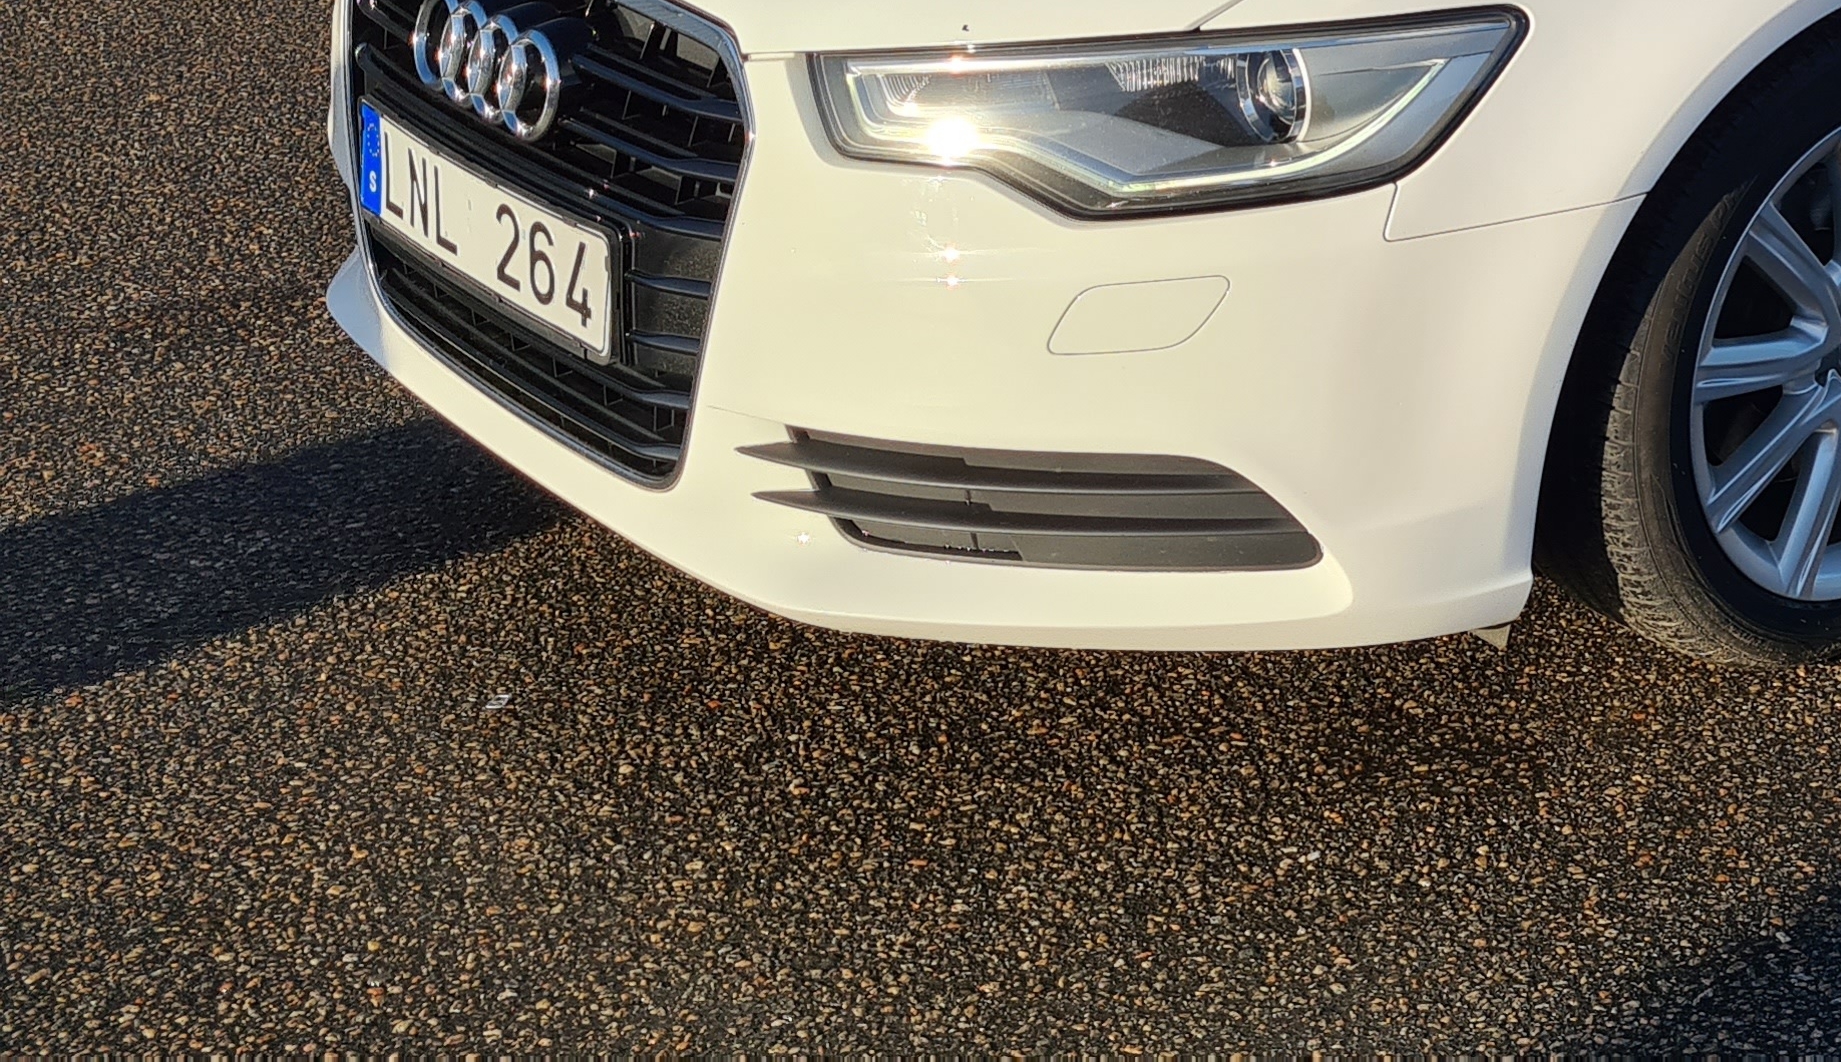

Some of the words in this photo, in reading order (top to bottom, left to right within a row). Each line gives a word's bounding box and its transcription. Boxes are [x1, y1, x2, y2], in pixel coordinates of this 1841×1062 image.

[369, 170, 377, 193] S
[385, 131, 458, 256] LNL
[496, 203, 592, 328] 264
